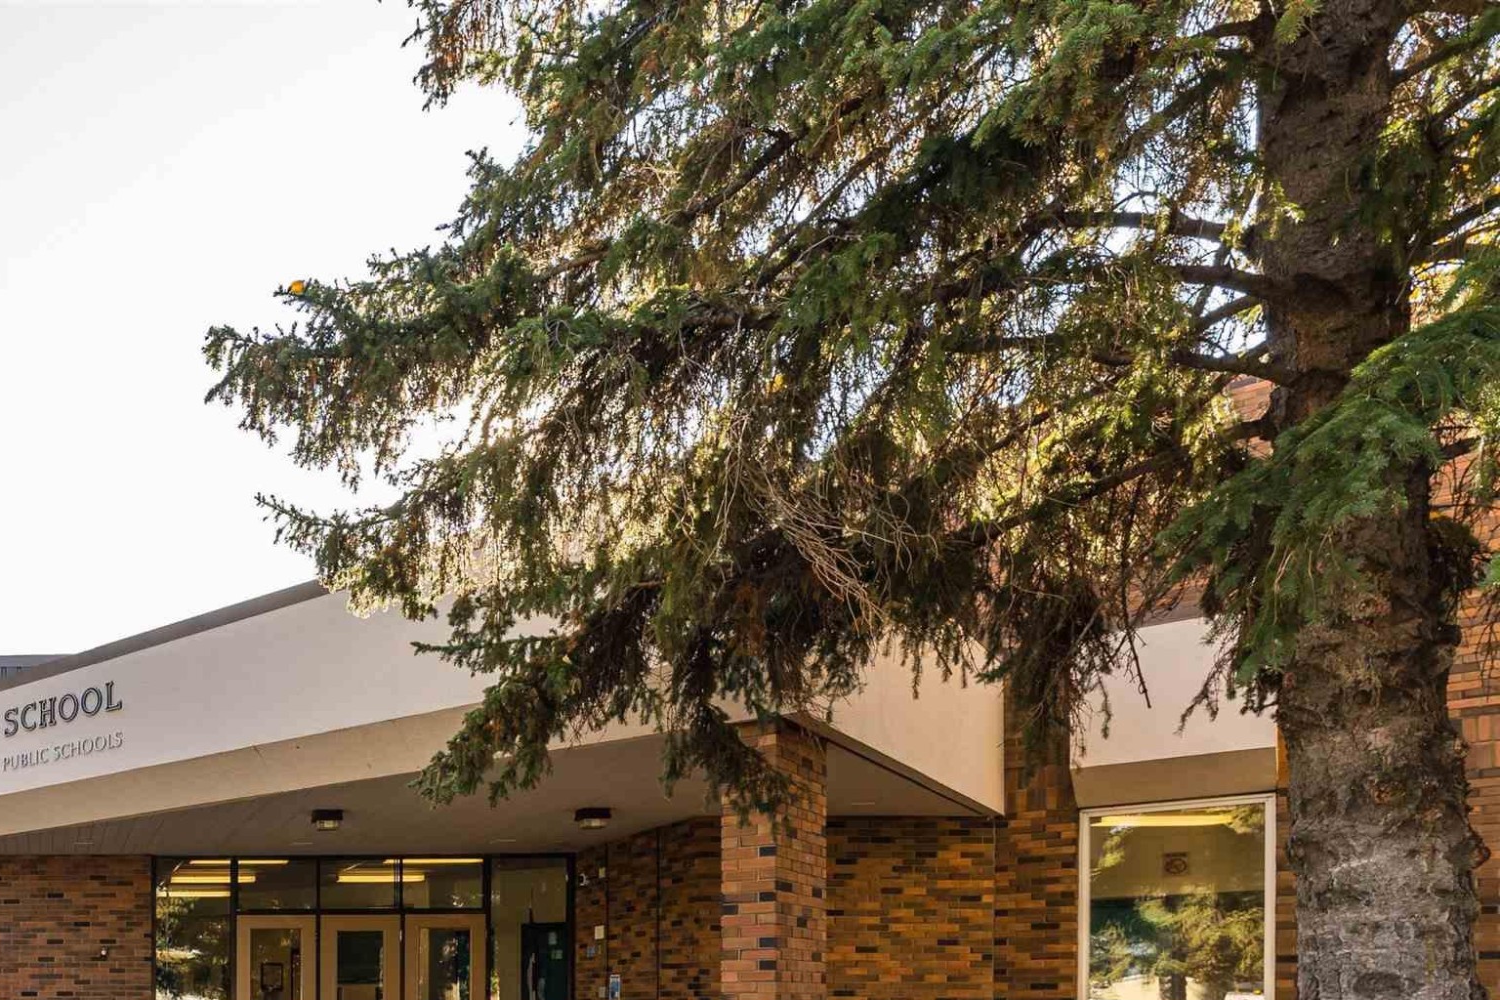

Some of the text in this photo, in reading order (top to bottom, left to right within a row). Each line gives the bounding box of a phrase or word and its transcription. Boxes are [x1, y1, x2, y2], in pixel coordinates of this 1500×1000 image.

[3, 680, 123, 737] SCHOOL
[3, 748, 49, 771] PUBLIC
[53, 731, 124, 762] SCHOOLS
